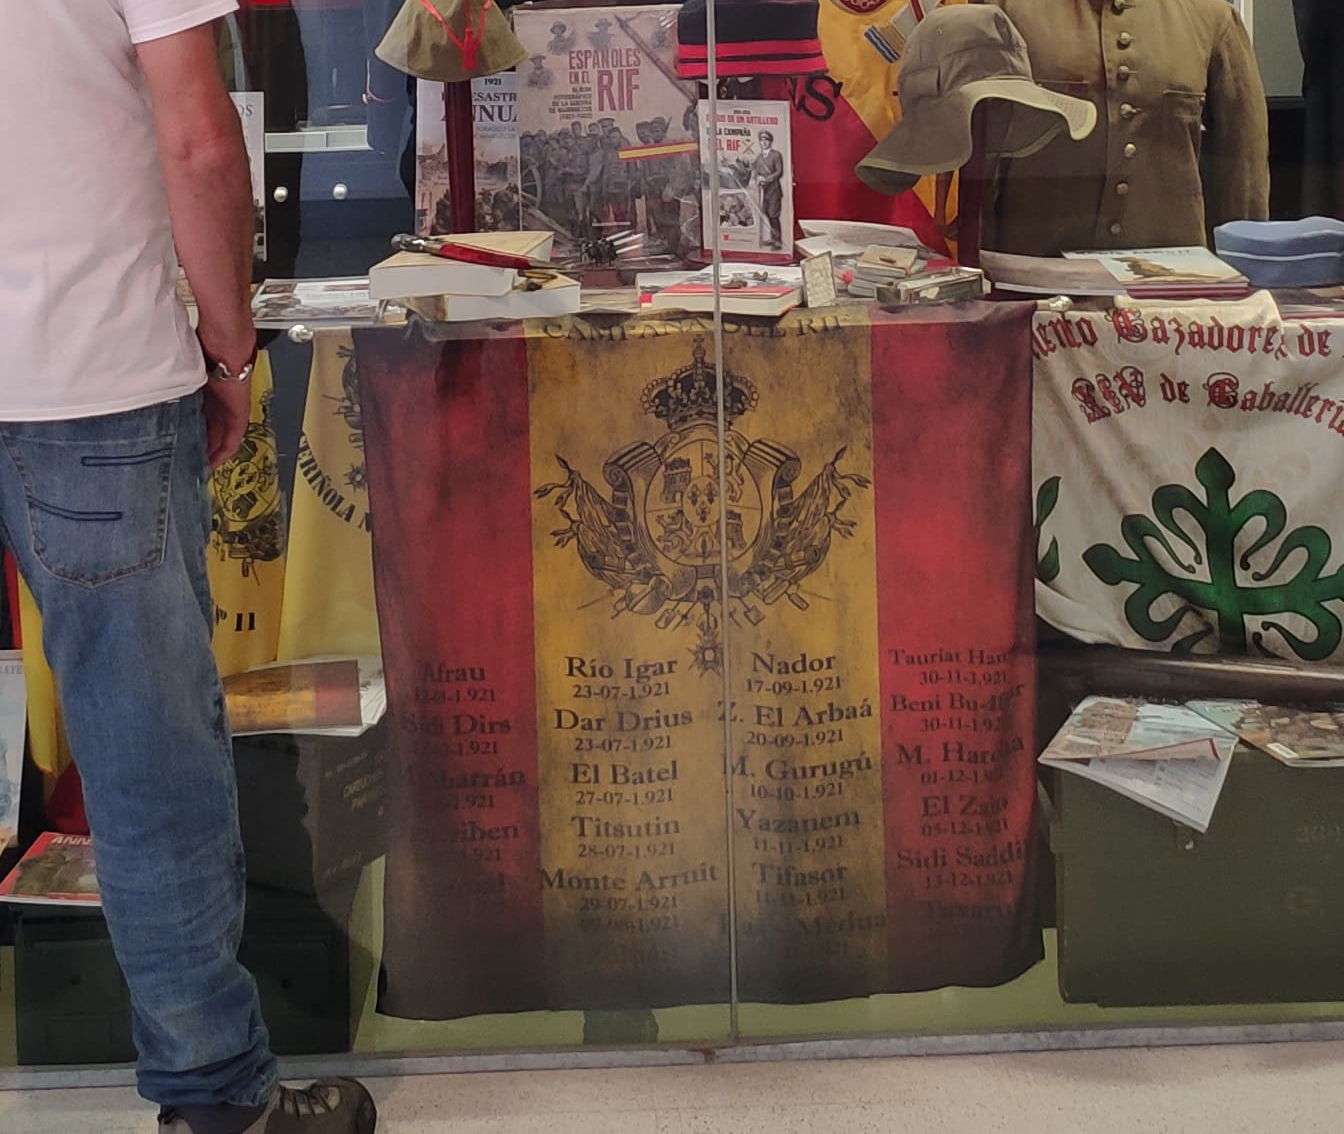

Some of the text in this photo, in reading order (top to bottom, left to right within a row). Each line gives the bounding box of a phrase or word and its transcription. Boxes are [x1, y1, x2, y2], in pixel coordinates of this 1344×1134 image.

[597, 68, 640, 112] RIF
[724, 126, 752, 137] CAMPAÑA
[725, 139, 741, 152] RIF
[1296, 324, 1332, 358] de
[1160, 373, 1191, 404] de
[750, 651, 836, 676] Nador
[887, 647, 963, 665] Tauriat
[564, 654, 678, 684] Río Igar
[745, 674, 842, 696] 17-09-1.921
[753, 704, 784, 728] El
[792, 697, 874, 727] Arbaá
[889, 692, 943, 713] Beni
[553, 707, 693, 734] Dar Drius
[573, 734, 672, 754] 23-07-1.921
[746, 727, 844, 748] 20-09-1.921
[896, 742, 932, 765] M.
[568, 759, 678, 787] El Batel
[720, 750, 874, 781] M. Gurugú
[575, 786, 673, 807] 27-07-1.921
[750, 780, 843, 802] 10-10-1.921
[921, 794, 951, 818] El
[577, 840, 675, 860] 28-07-1.921
[752, 834, 844, 855] 11-11-1.921
[896, 848, 948, 870] Sidi
[540, 861, 718, 892] Monte Arruit
